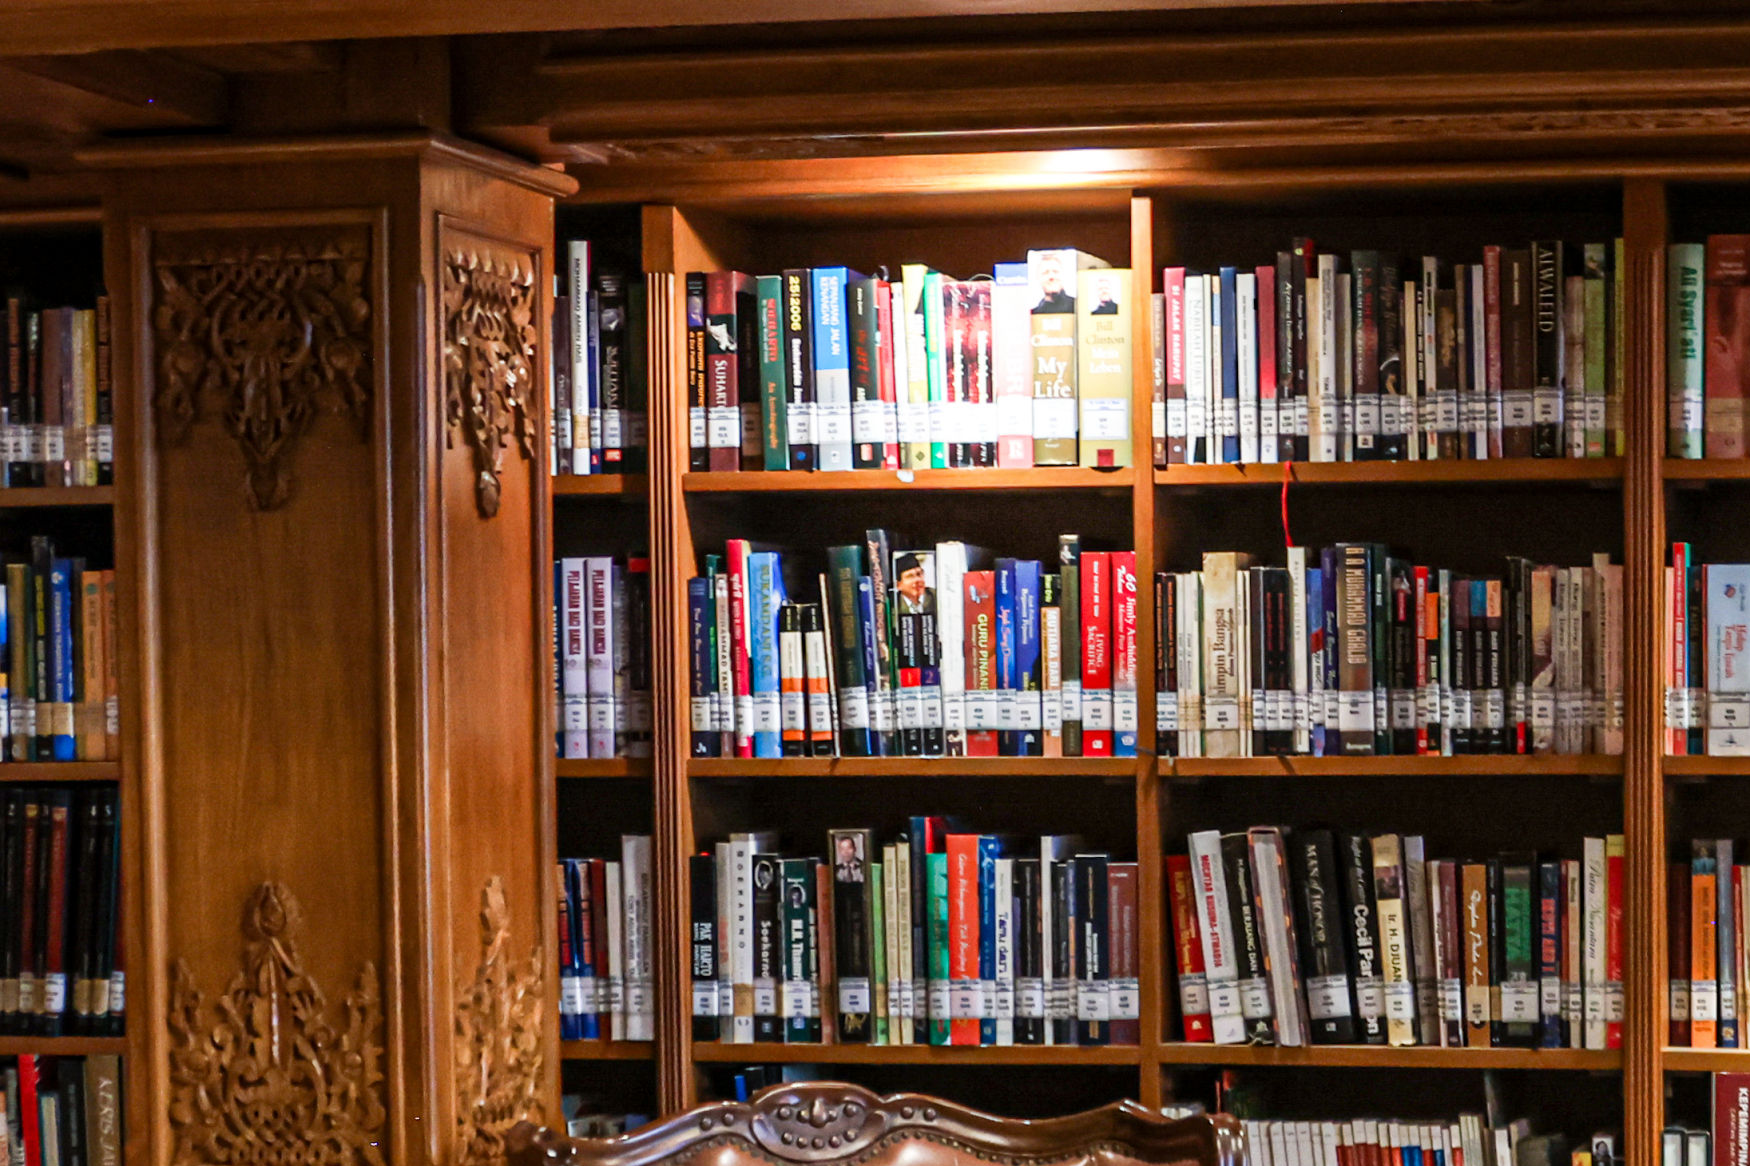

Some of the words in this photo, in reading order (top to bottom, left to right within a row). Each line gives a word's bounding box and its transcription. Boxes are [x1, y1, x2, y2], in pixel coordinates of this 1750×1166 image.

[1539, 248, 1555, 333] ALWALEED
[1037, 356, 1069, 381] My
[1033, 380, 1073, 399] Life
[1125, 573, 1137, 593] 60
[1346, 569, 1367, 626] MUHAMMAD
[978, 614, 989, 648] GURU
[1050, 609, 1061, 657] MUTIARA
[1213, 607, 1229, 652] Bangsa
[1346, 629, 1367, 665] GHALIB
[1087, 625, 1098, 675] SACRIFICE
[1095, 633, 1105, 668] LIVING
[1050, 660, 1061, 687] DARI
[1305, 844, 1318, 878] MAN
[700, 922, 713, 941] PAK
[1353, 903, 1374, 947] Cecil
[700, 944, 713, 977] HARTO
[761, 919, 772, 978] Soekarno
[1390, 943, 1402, 983] DJUAN
